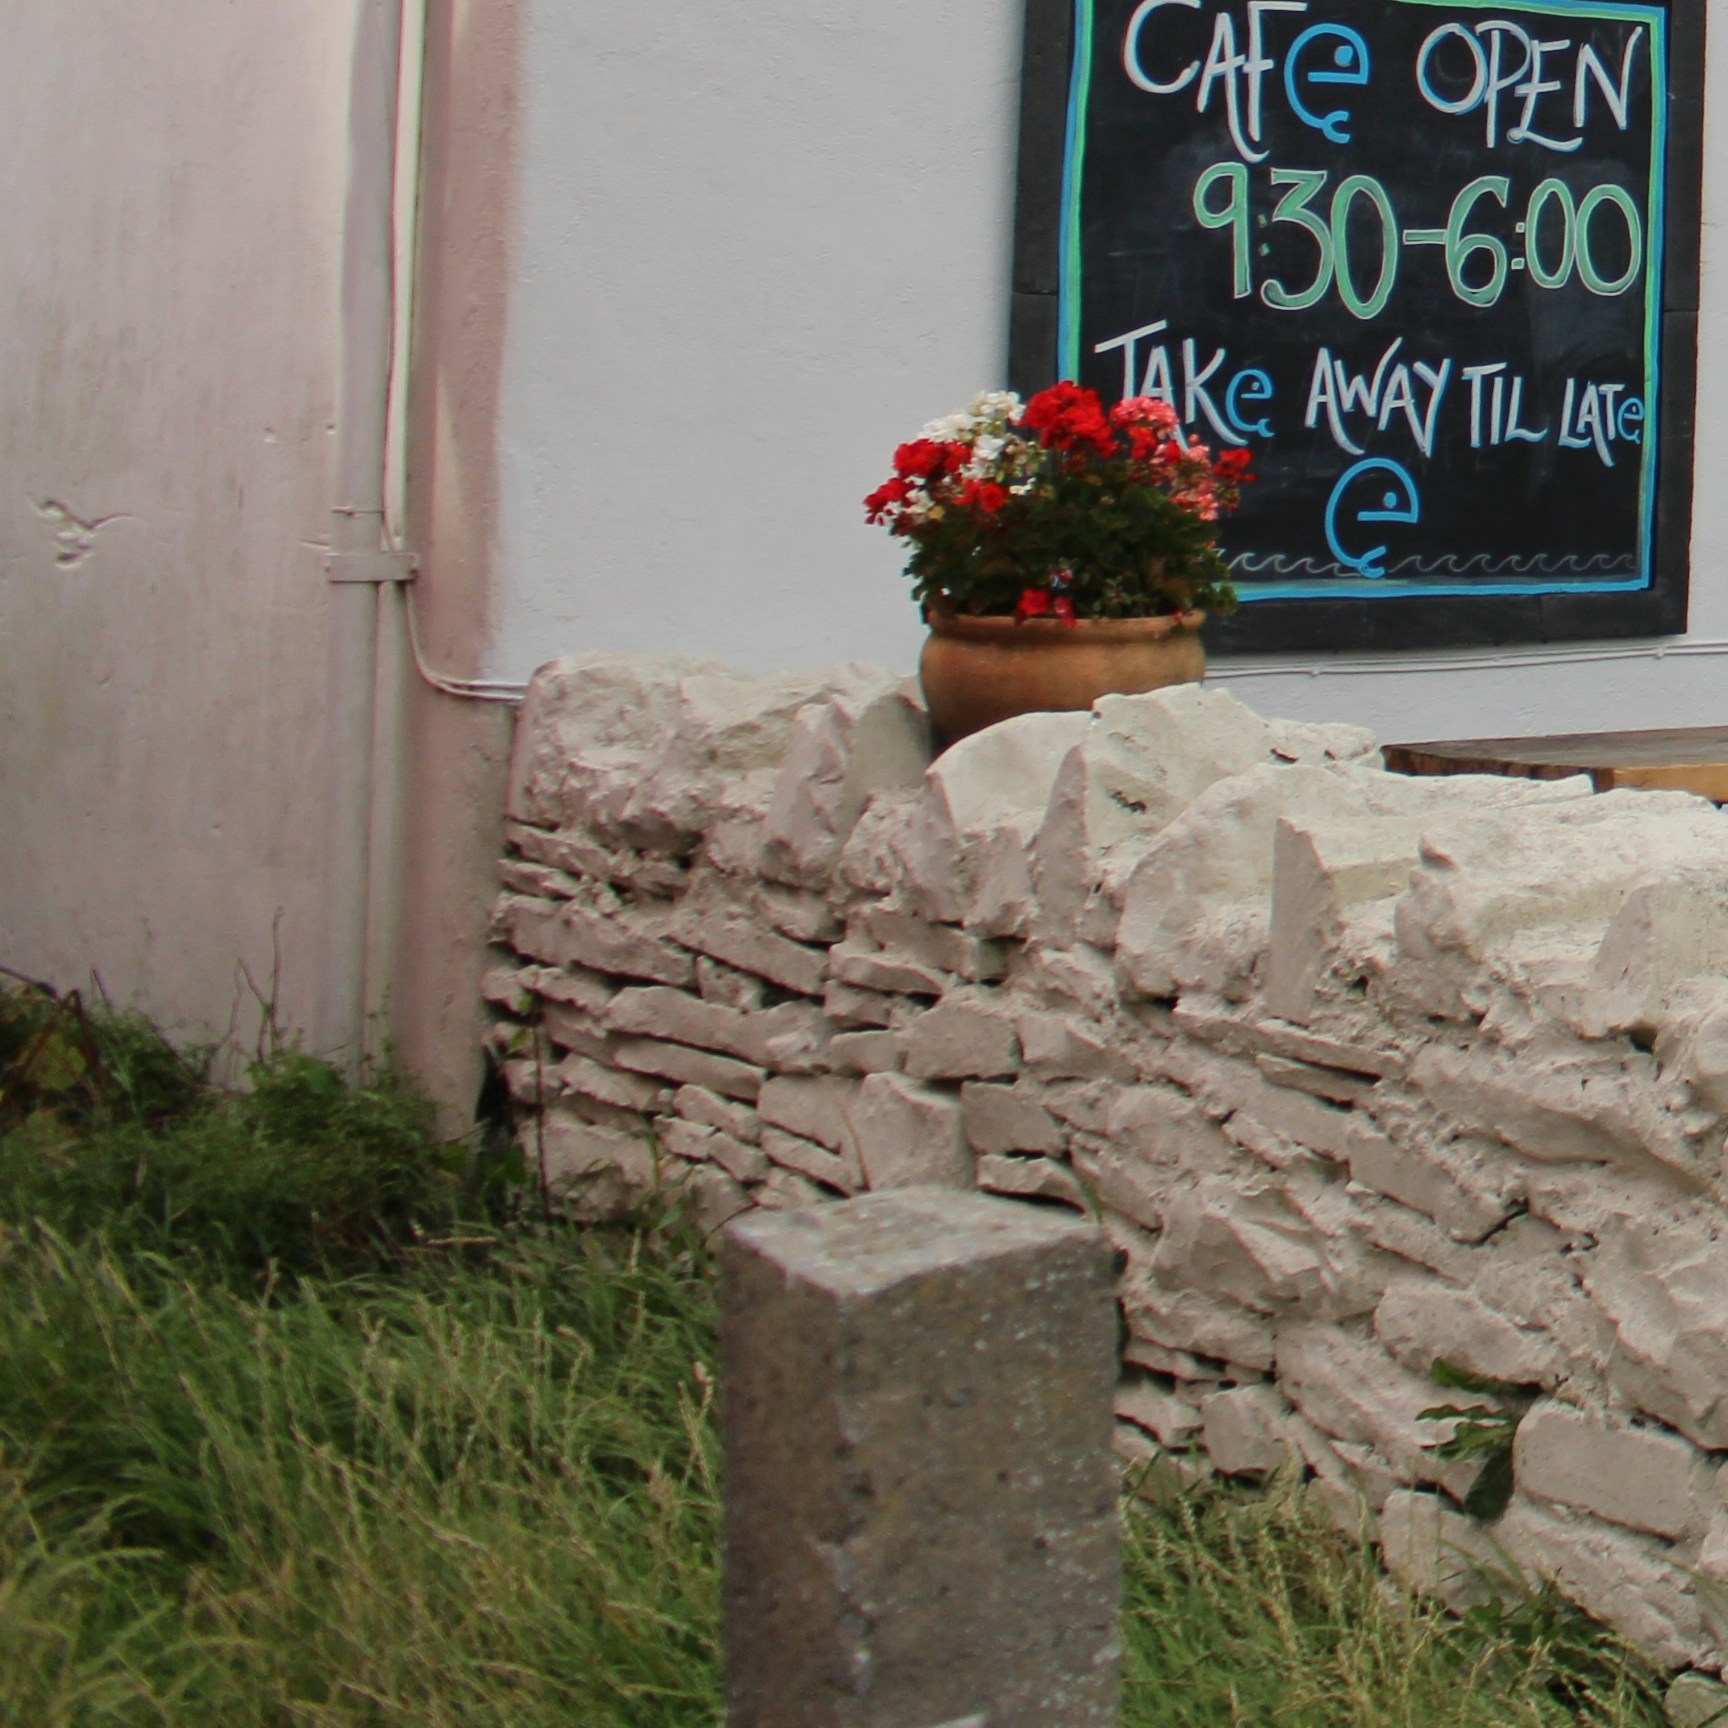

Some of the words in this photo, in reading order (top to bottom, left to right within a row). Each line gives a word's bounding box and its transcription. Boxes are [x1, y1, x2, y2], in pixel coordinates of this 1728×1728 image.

[1416, 19, 1644, 151] OPEN
[1304, 336, 1451, 458] AWAY
[1462, 362, 1548, 449] TIL
